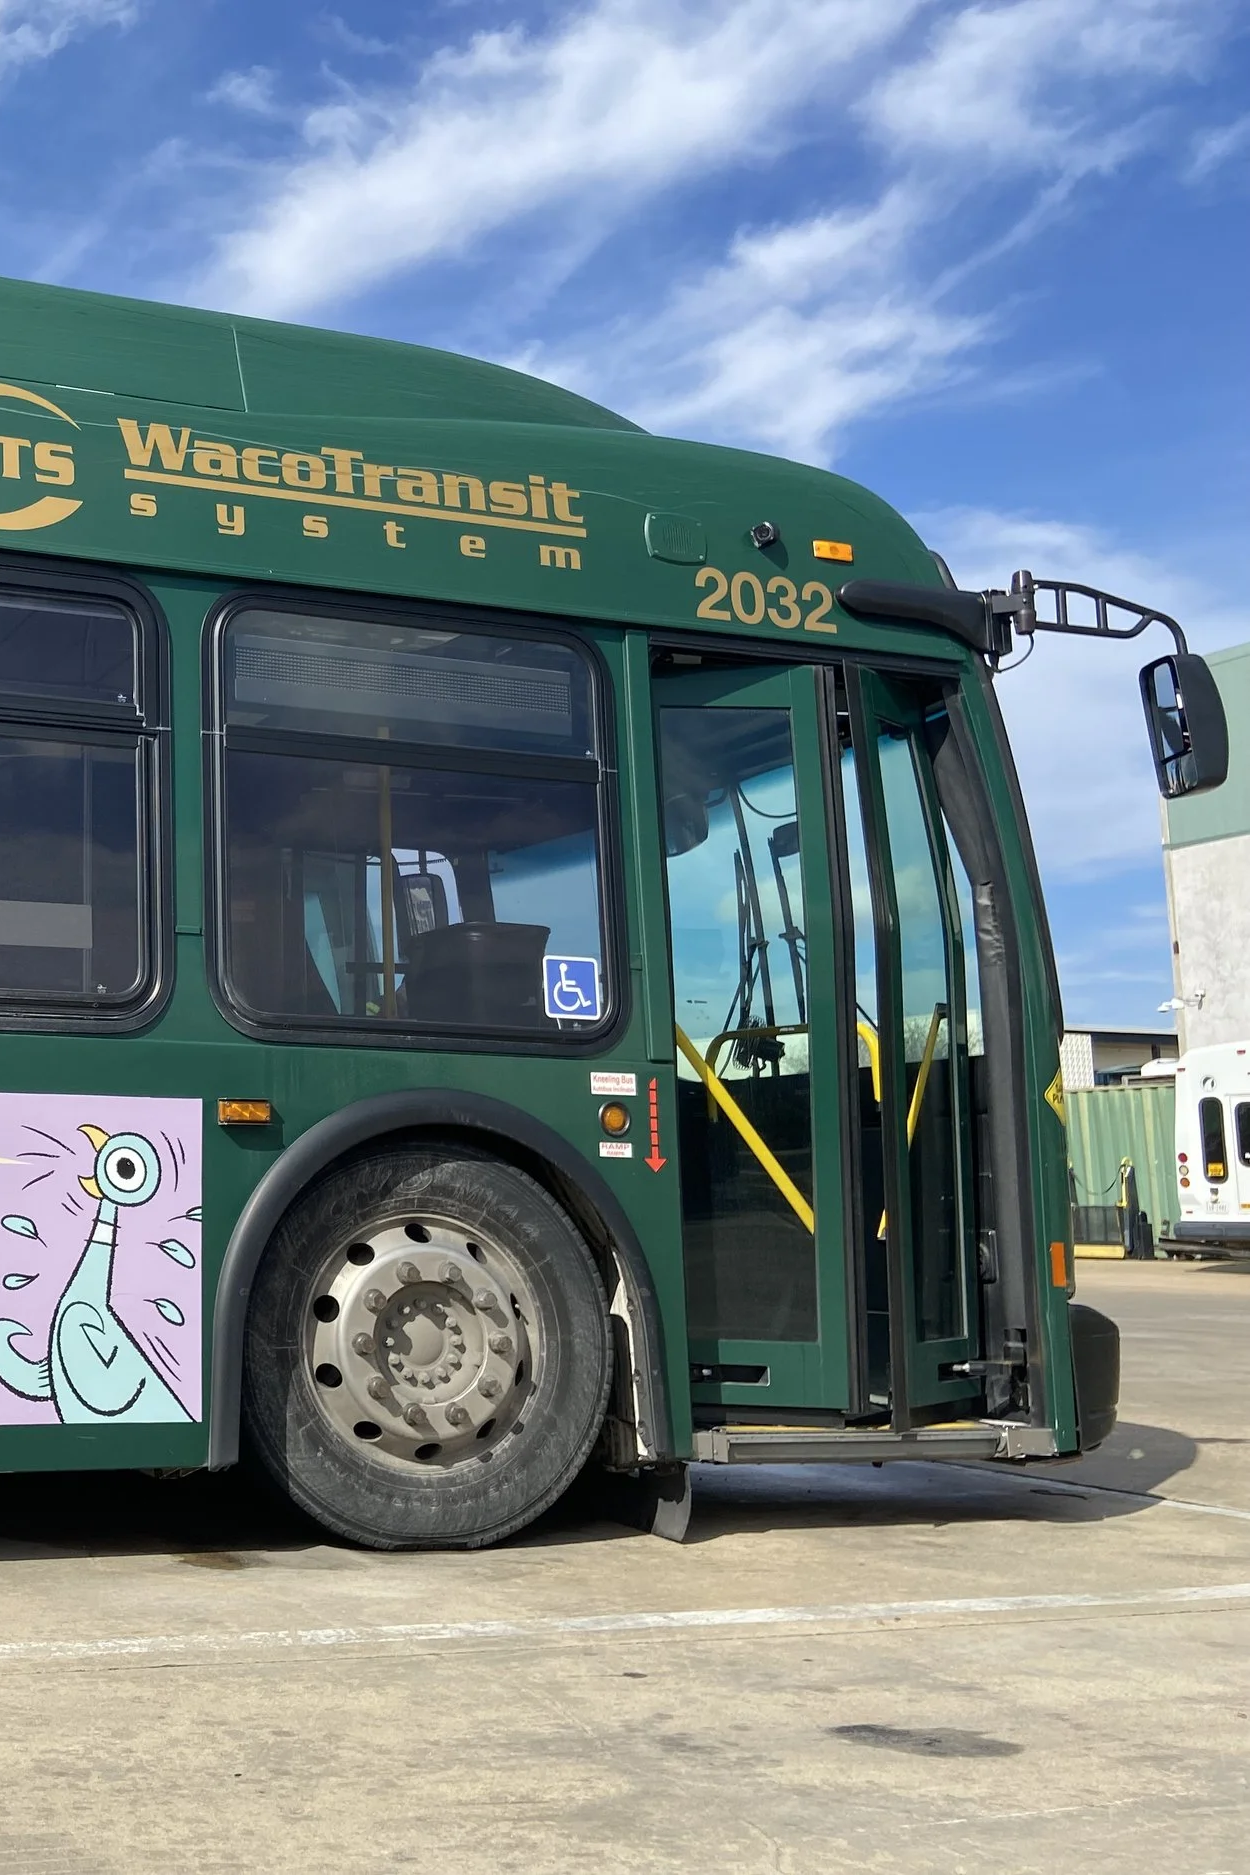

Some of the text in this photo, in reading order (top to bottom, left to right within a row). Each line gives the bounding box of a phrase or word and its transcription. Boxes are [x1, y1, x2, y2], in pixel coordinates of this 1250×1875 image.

[695, 567, 838, 634] 2032
[593, 1074, 633, 1085] Kneeling Bus
